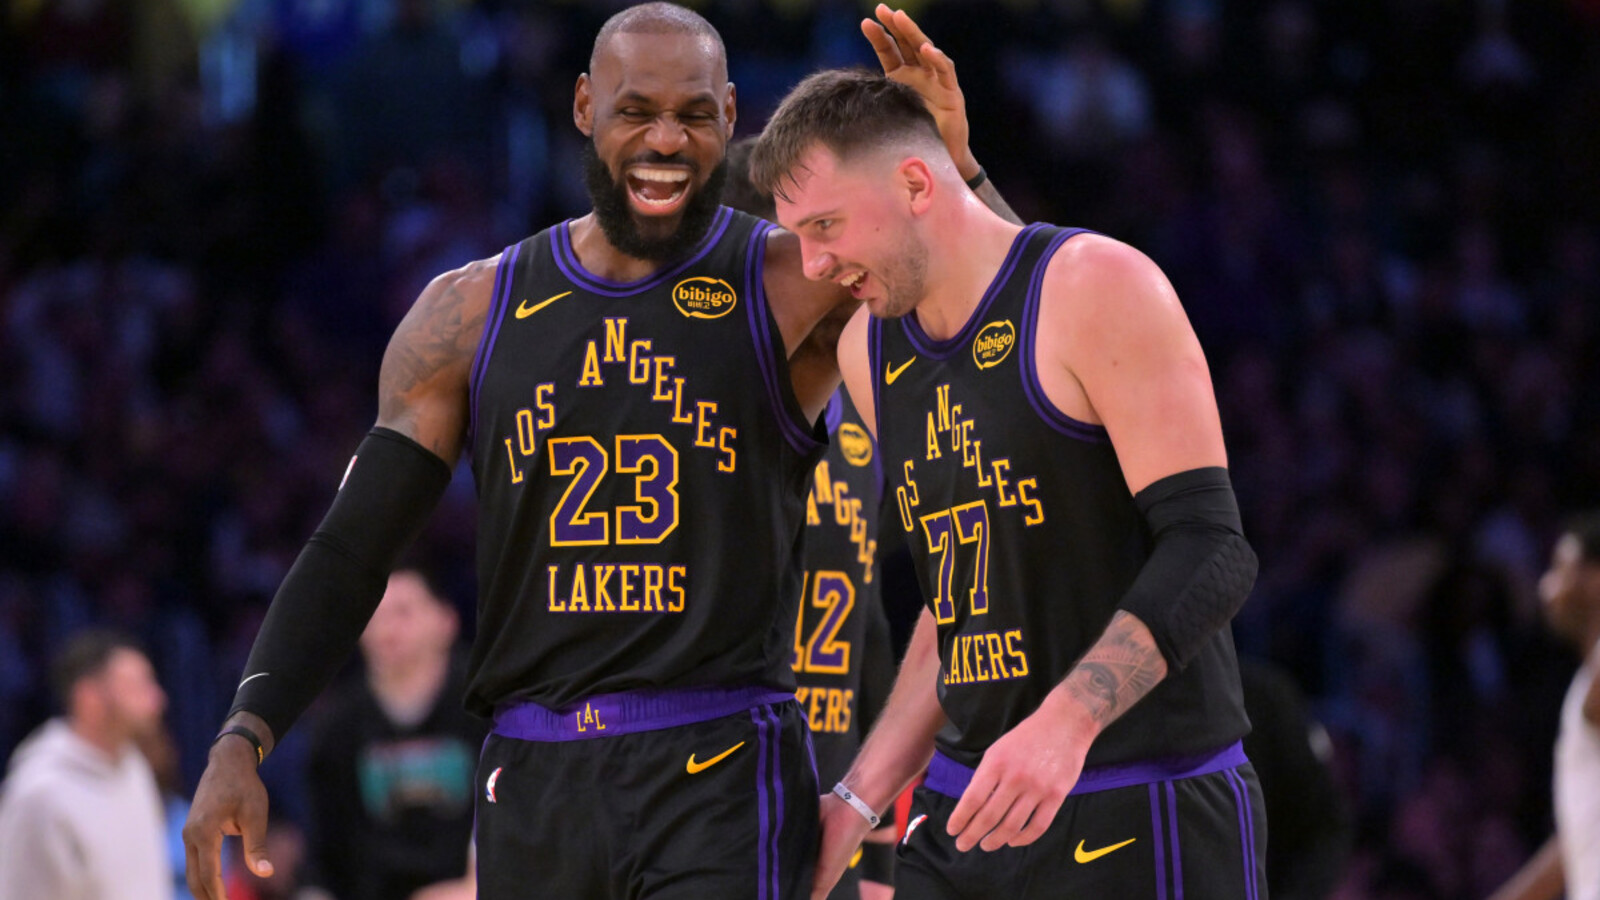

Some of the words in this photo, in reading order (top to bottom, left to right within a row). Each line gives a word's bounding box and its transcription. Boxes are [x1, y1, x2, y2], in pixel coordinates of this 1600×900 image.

[678, 286, 733, 307] bibigo
[977, 332, 1013, 353] bibigo
[504, 383, 555, 484] LOS
[578, 317, 737, 473] ANGELES
[547, 433, 679, 547] 23
[896, 459, 920, 532] OS
[926, 383, 1045, 527] ANGELES
[806, 459, 877, 584] ANGELE
[918, 499, 990, 625] 77
[547, 564, 687, 613] LAKERS
[791, 570, 856, 674] 2
[943, 629, 1029, 685] AKERS
[576, 702, 606, 732] LAL
